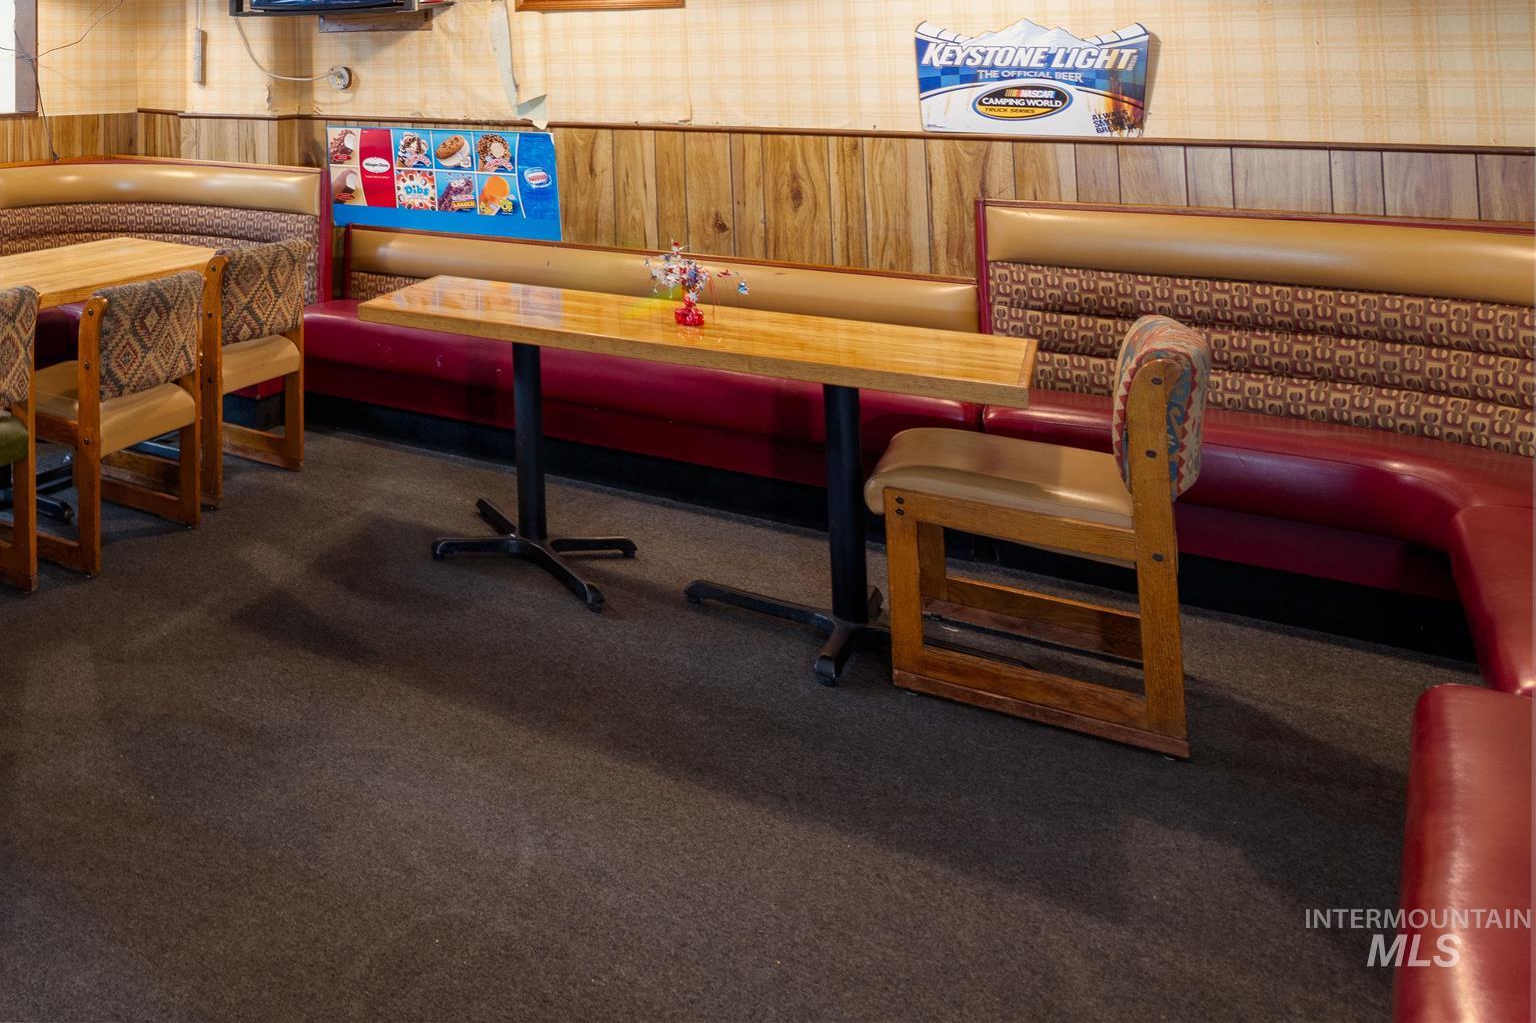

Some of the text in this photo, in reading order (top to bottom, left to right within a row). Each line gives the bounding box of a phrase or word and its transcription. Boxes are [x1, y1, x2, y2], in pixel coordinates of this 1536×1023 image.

[921, 43, 1049, 68] KEYSTONE
[1051, 47, 1138, 69] LIGHT
[977, 70, 1083, 83] THE OFFICIAL BEER
[1020, 90, 1056, 98] NASCAR
[982, 98, 1062, 107] CAMPING WORLD
[404, 184, 429, 196] Dibs
